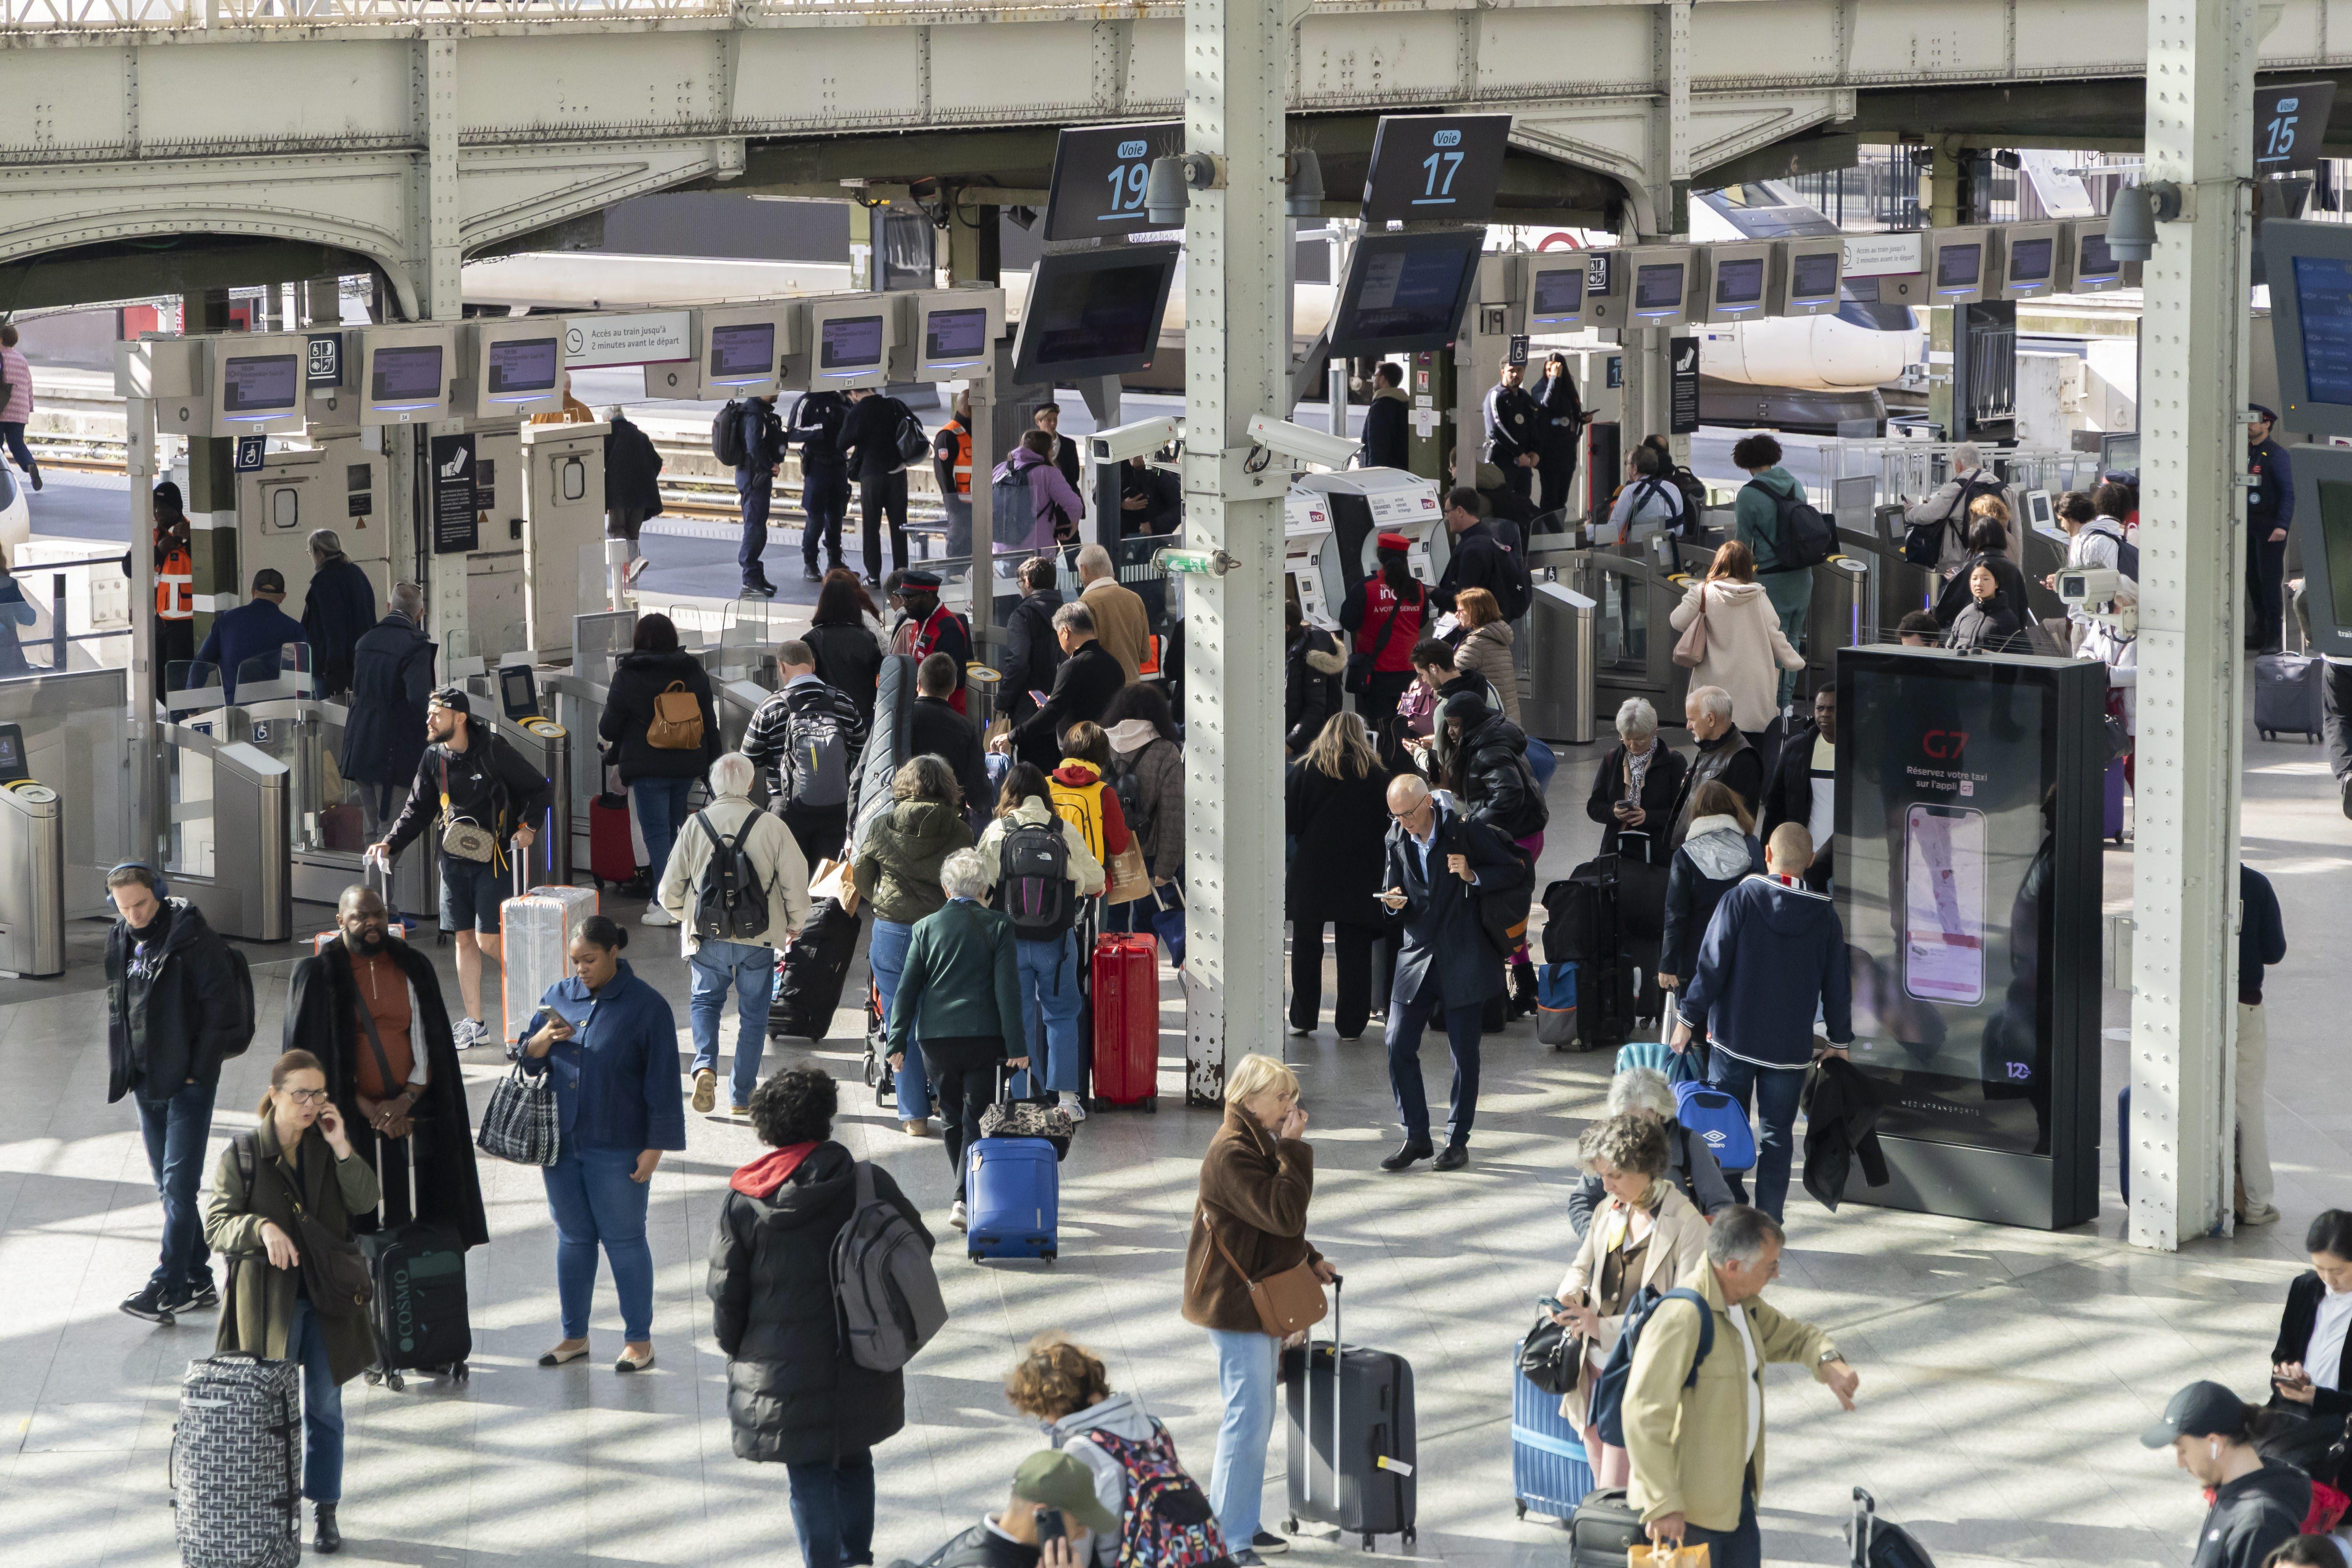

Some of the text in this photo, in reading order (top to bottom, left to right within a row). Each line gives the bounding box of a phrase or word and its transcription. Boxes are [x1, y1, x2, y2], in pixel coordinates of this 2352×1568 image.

[2280, 100, 2295, 111] Voie
[1438, 132, 1457, 144] Voie
[2267, 116, 2299, 154] 15
[1122, 143, 1143, 156] Voie
[1423, 152, 1465, 195] 17
[1108, 163, 1149, 210] 19
[1899, 254, 1915, 262] départ
[592, 329, 611, 338] Accès
[624, 327, 640, 336] train
[641, 325, 666, 336] jusqu'à
[598, 341, 626, 350] minutes
[657, 337, 679, 347] départ
[1612, 367, 1622, 383] 1
[1923, 729, 1970, 759] G7
[1906, 766, 1987, 781] Réservez votre taxi
[1931, 780, 1957, 791] l'appli
[394, 1270, 412, 1336] COSMO
